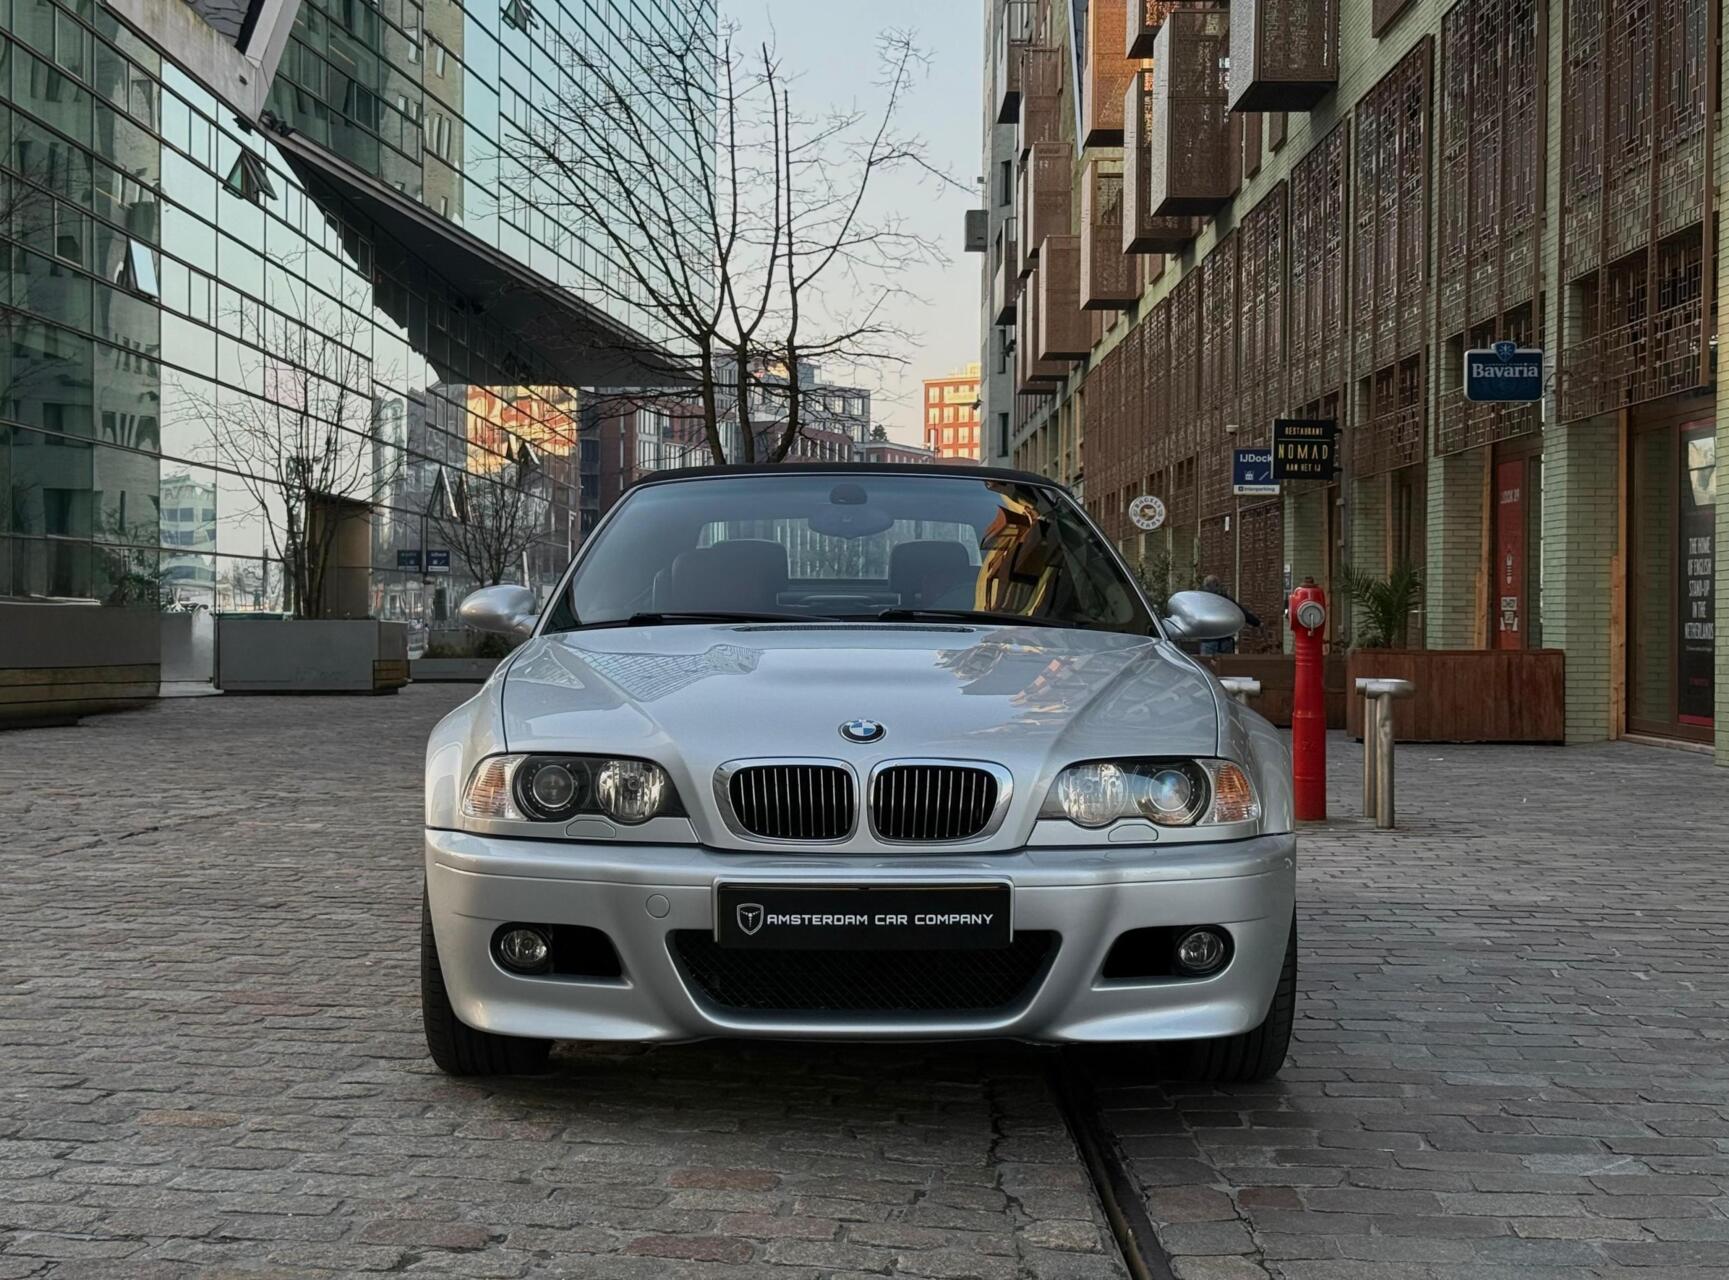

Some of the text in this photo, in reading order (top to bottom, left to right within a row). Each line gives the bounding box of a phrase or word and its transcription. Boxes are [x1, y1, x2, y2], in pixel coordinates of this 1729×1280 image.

[1472, 362, 1539, 378] Bavaria
[1285, 427, 1323, 436] RESTAURANT
[1240, 453, 1273, 463] IJDock
[1278, 444, 1329, 460] NOMAD
[1684, 622, 1714, 640] NETHERLANDS
[767, 913, 994, 925] AMSTERDAM CAR COMPANY
